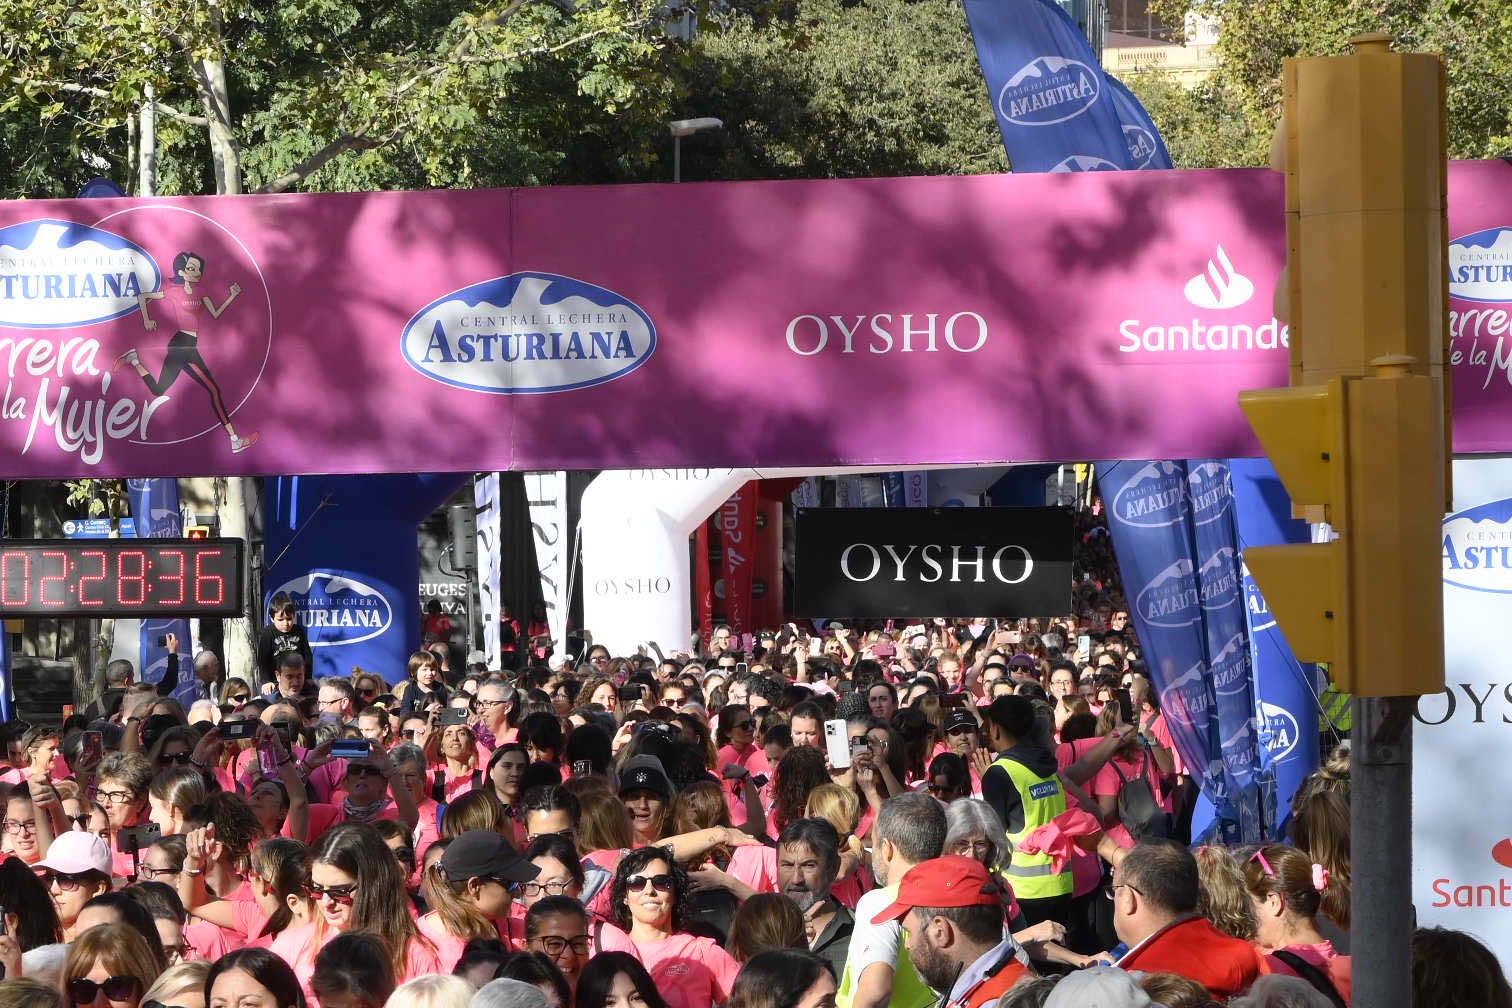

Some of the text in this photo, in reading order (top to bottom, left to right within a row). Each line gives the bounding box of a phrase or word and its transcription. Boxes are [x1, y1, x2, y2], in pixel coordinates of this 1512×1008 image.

[421, 319, 637, 364] ASTURIANA
[460, 313, 628, 327] CENTRAL LECHERA
[785, 311, 989, 356] OYSHO
[1469, 339, 1487, 366] la
[2, 377, 27, 420] la
[22, 372, 171, 466] Mujer
[1, 550, 224, 606] 02:28:36
[840, 541, 1035, 585] OYSHO
[595, 577, 671, 595] OYSHO
[1432, 878, 1511, 908] Sant
